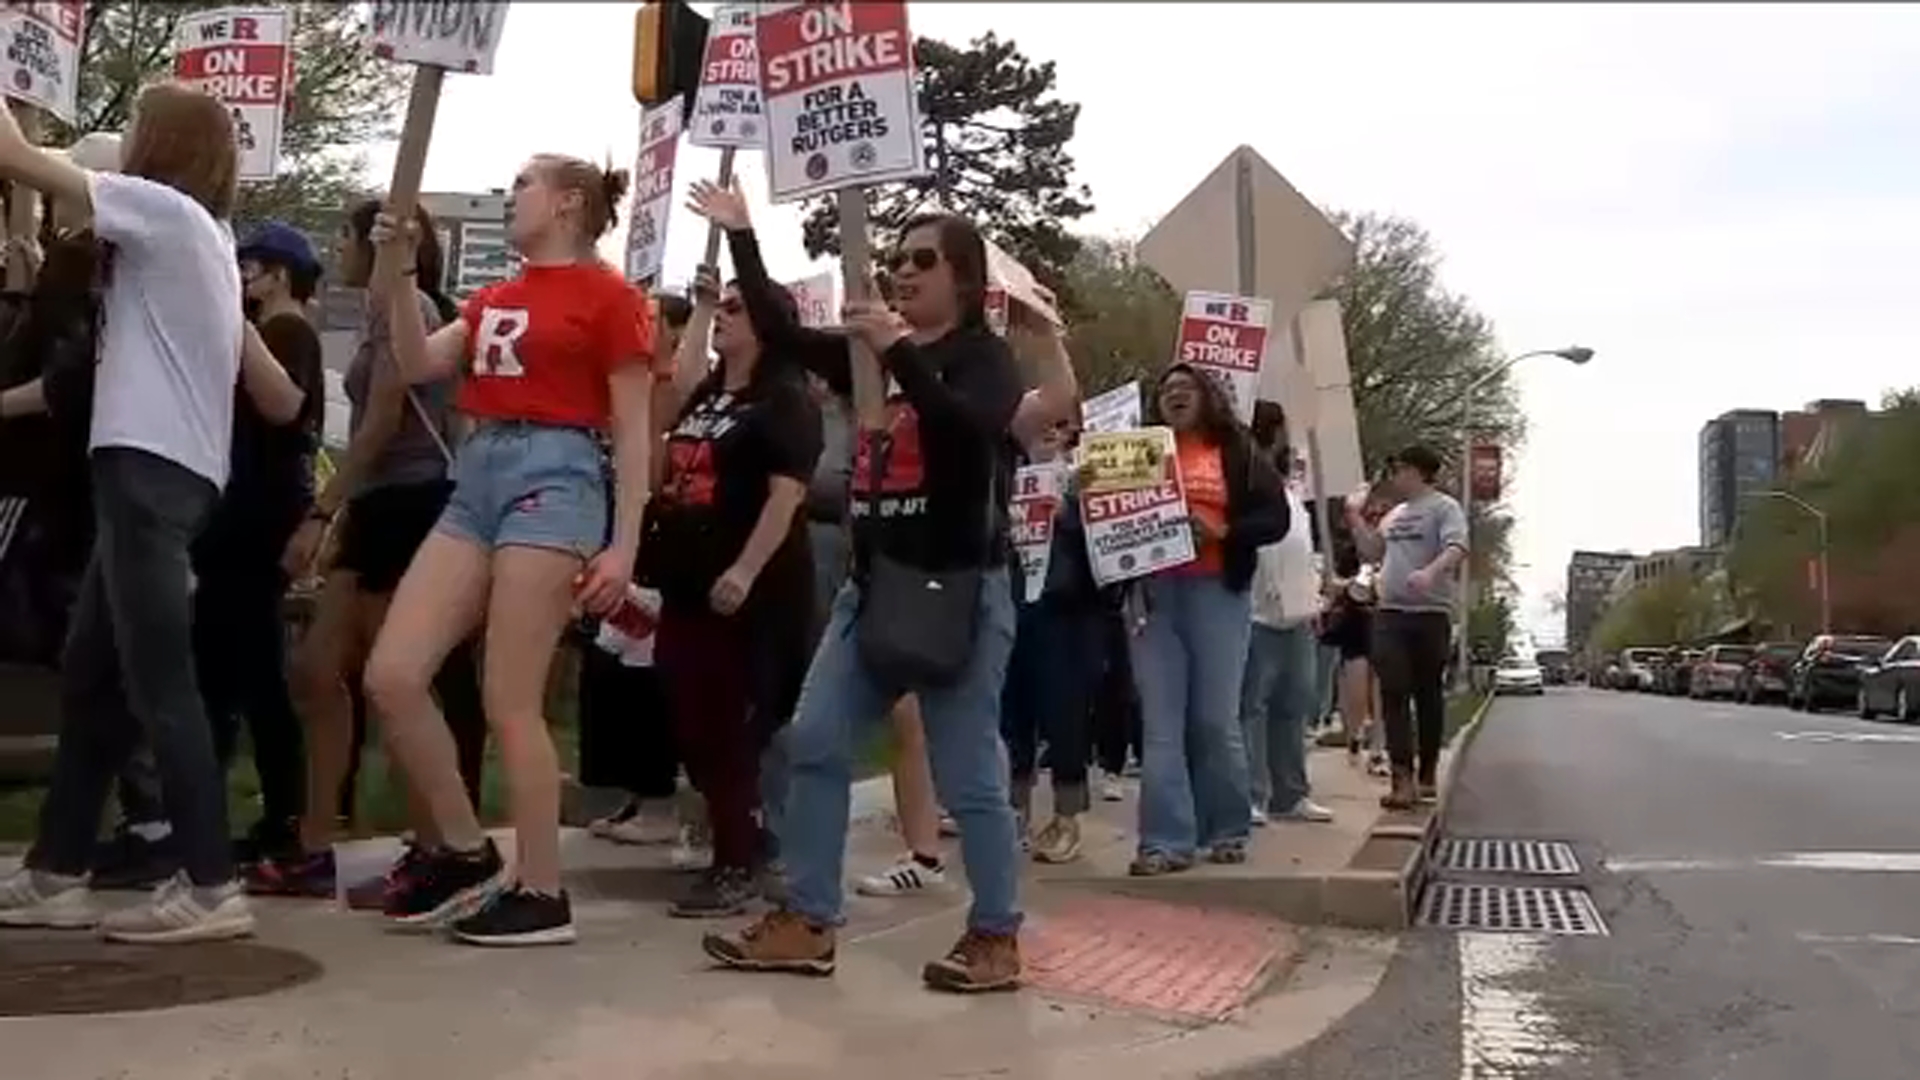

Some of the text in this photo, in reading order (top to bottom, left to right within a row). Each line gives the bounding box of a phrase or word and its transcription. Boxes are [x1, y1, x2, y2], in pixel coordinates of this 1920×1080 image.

[201, 18, 258, 40] WE R
[801, 3, 853, 42] ON
[204, 49, 245, 73] ON
[768, 31, 900, 89] STRIKE
[204, 75, 278, 99] RIKE
[804, 81, 865, 110] FOR A
[797, 100, 878, 133] BETTER
[791, 117, 889, 155] RUTGERS
[473, 306, 529, 376] R
[1207, 325, 1239, 346] ON
[1183, 341, 1257, 367] STRIKE
[1088, 479, 1177, 518] STRIKE
